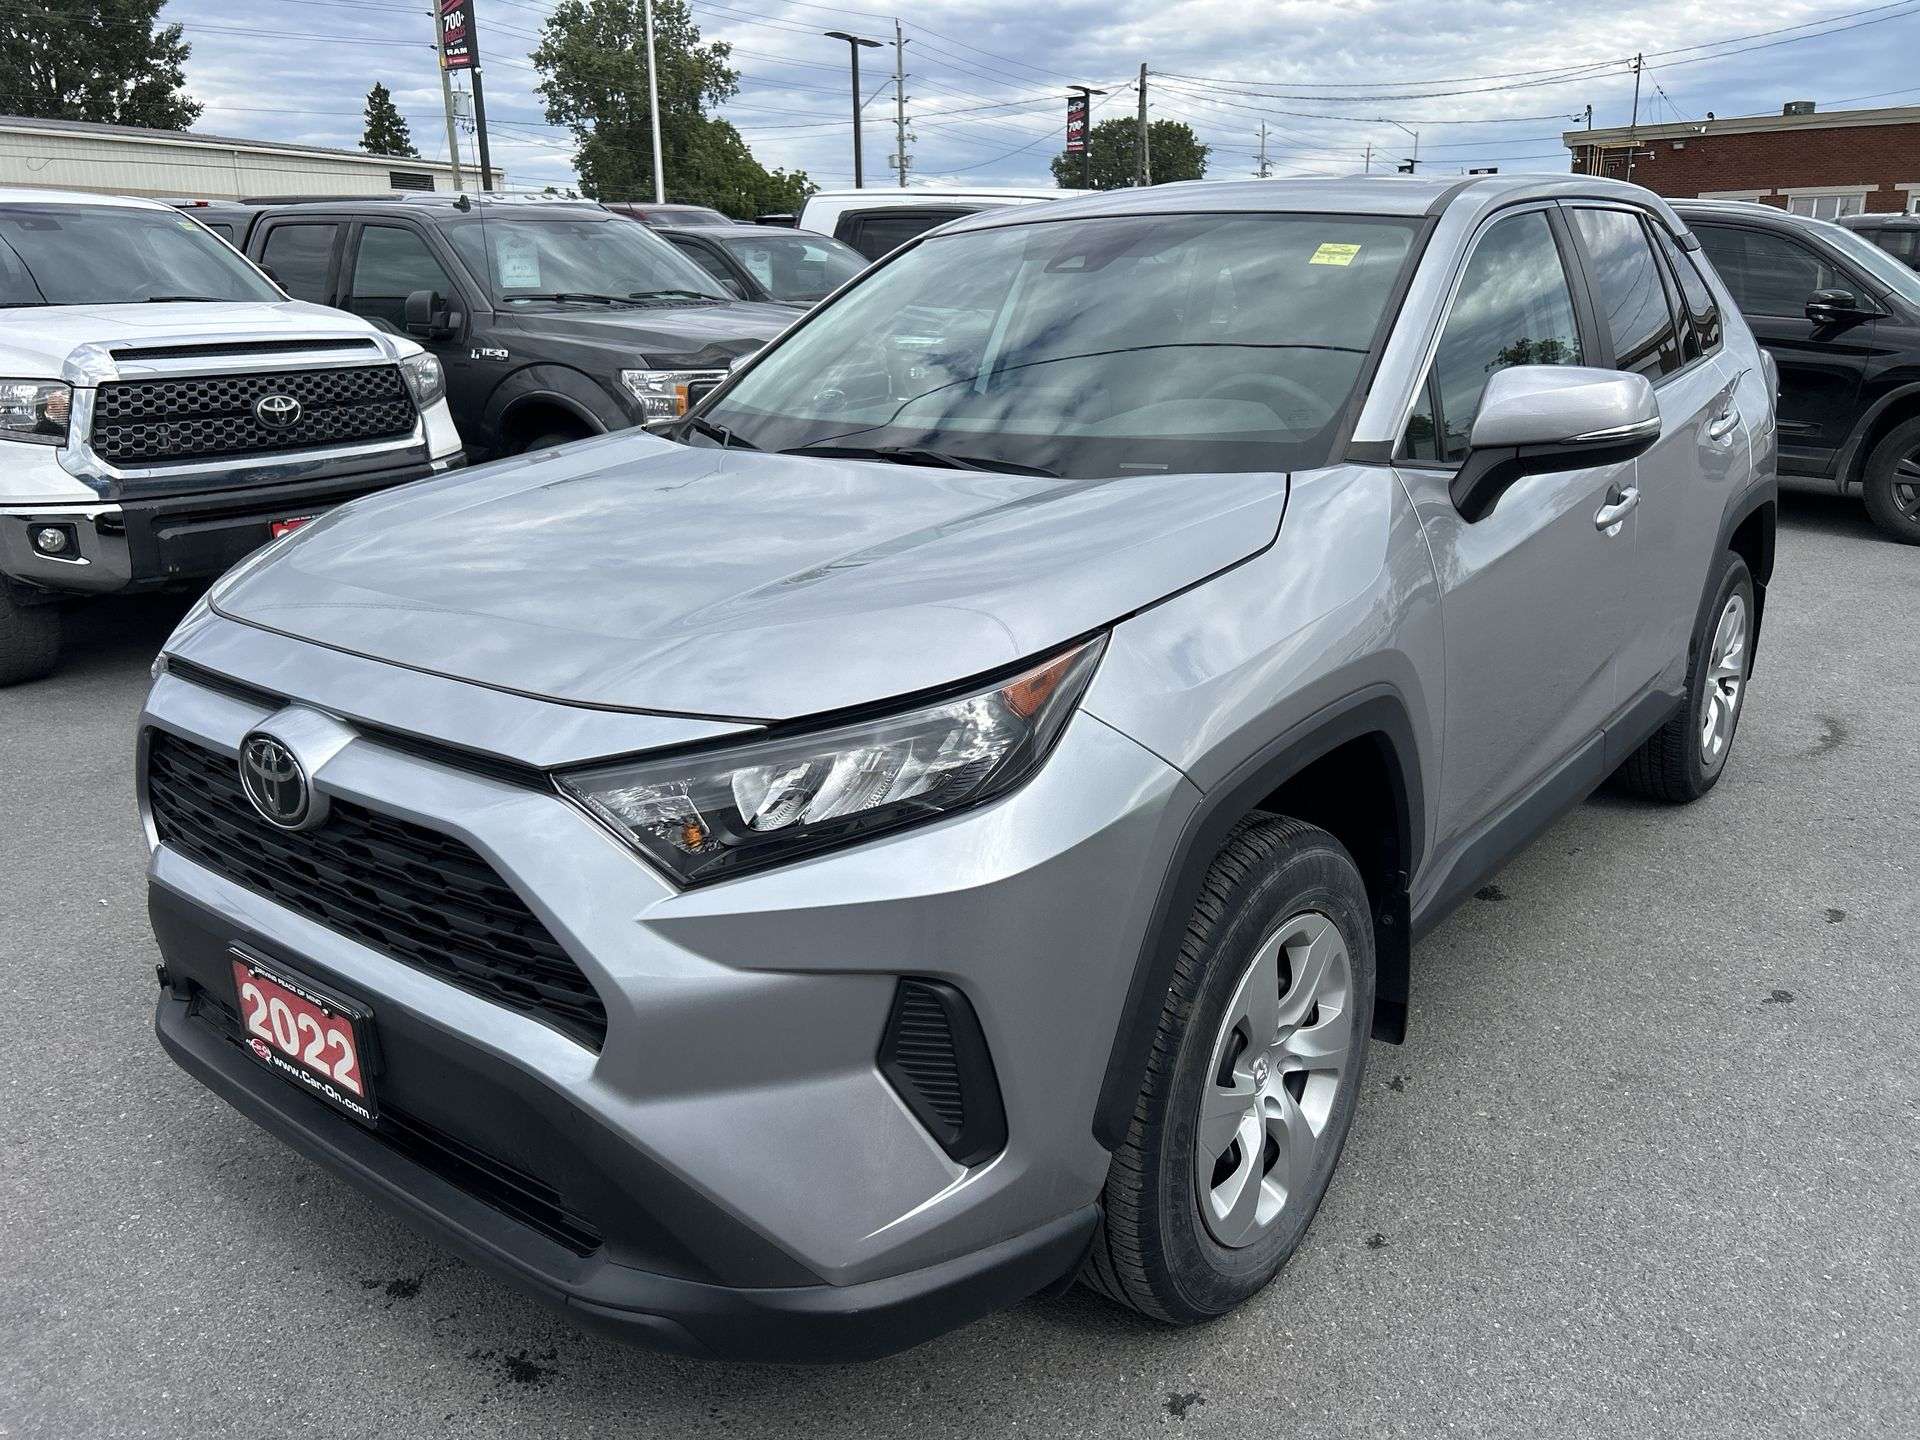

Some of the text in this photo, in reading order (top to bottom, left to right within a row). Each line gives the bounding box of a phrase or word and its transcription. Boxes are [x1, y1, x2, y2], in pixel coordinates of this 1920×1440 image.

[443, 10, 465, 32] 700+
[446, 47, 468, 56] RAM
[242, 982, 361, 1094] 2022
[272, 1056, 371, 1119] www.Car-On.com
